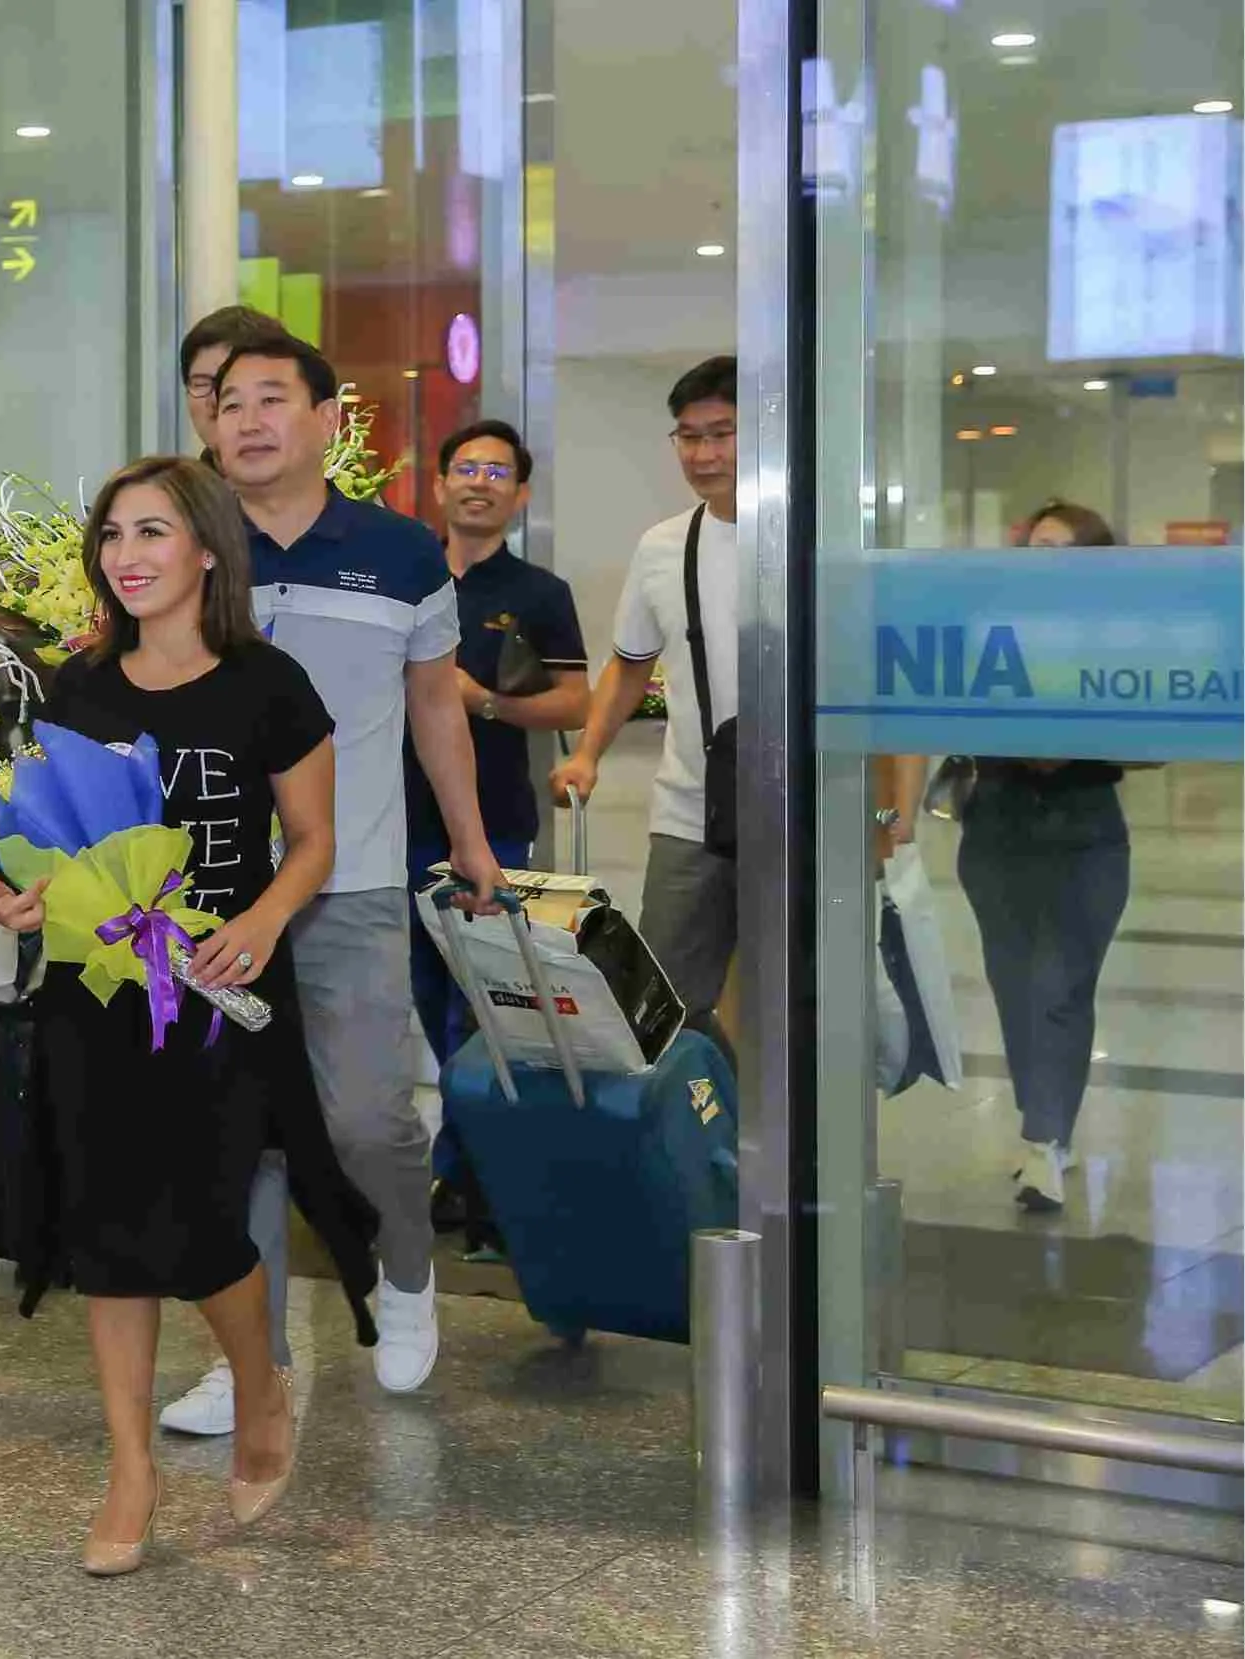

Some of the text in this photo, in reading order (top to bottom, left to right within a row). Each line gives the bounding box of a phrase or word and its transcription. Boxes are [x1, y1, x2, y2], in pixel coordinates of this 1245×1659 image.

[876, 625, 1034, 697] NIA
[1079, 669, 1152, 699] NOI
[159, 749, 240, 800] VE
